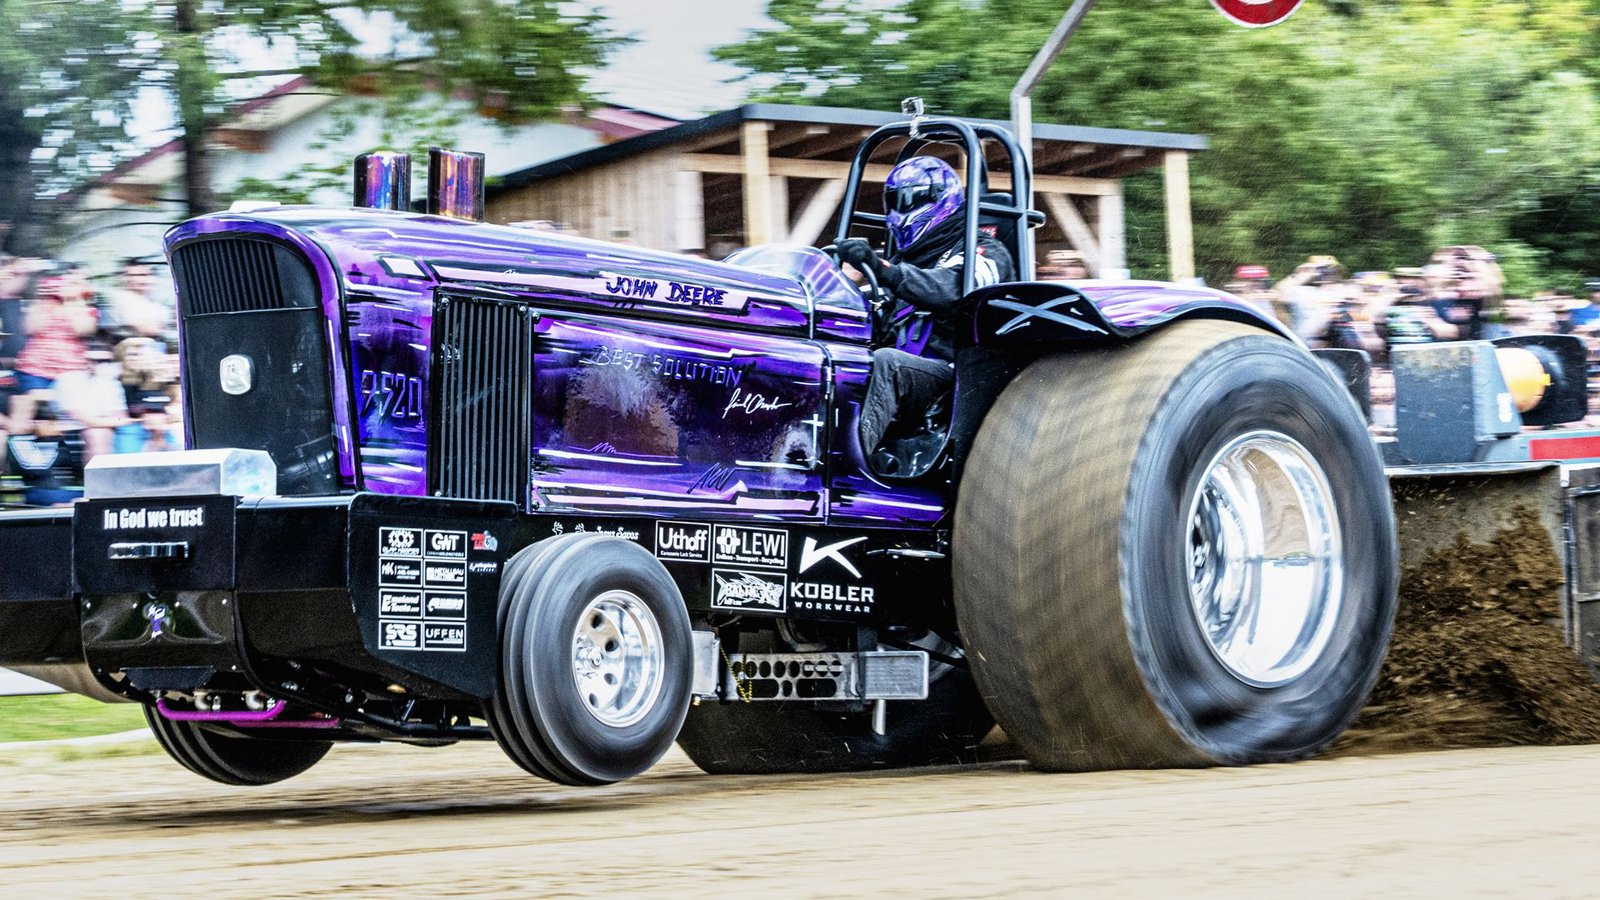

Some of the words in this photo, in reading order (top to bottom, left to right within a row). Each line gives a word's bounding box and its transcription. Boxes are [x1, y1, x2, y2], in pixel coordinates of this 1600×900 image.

[606, 276, 658, 298] JOHN
[665, 281, 728, 306] DEERE
[581, 346, 644, 372] BEST
[652, 354, 742, 387] SOLUTION
[104, 509, 118, 529] In
[119, 508, 146, 529] God
[147, 510, 168, 528] we
[169, 507, 203, 527] trust
[741, 531, 785, 557] LEWI
[794, 601, 871, 613] WORKWEAR
[425, 628, 464, 639] UFFEN
